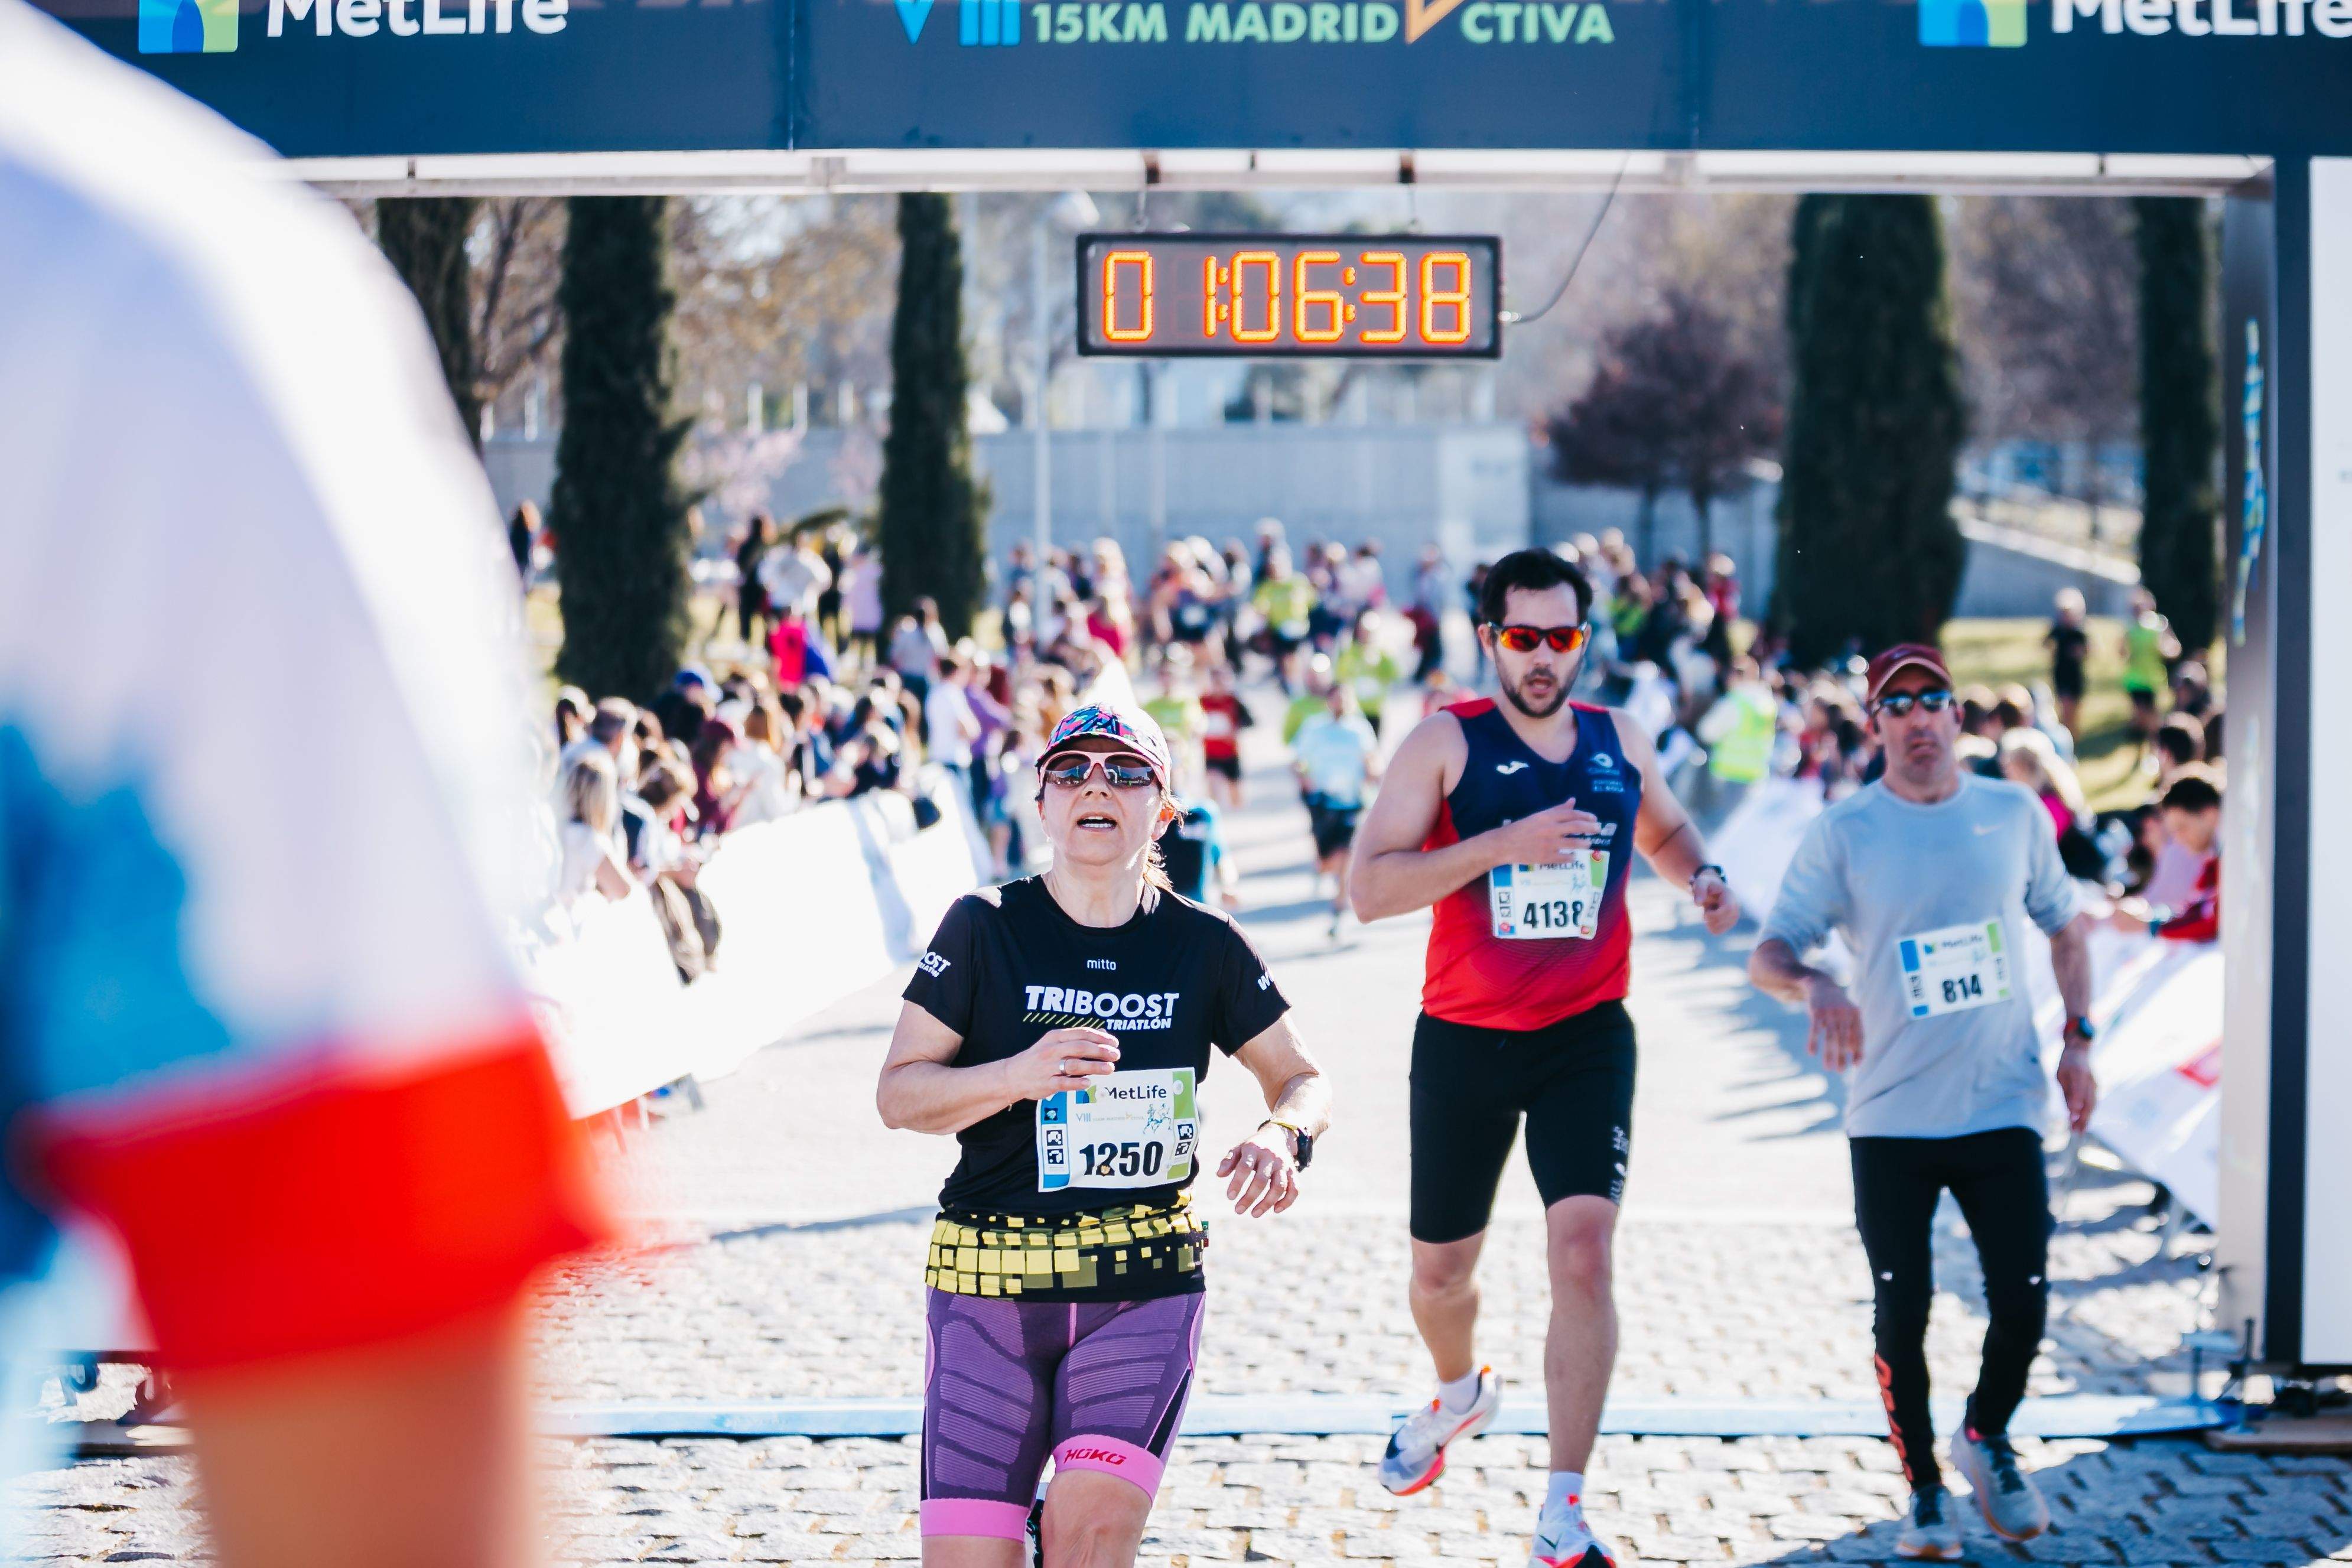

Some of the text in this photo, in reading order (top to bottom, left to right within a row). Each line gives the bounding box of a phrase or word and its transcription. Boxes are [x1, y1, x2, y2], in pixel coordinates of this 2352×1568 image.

[1030, 2, 1169, 43] 15KM
[1186, 2, 1399, 43] MADRID
[1105, 251, 1153, 341] 0
[1524, 900, 1583, 929] 4138
[1087, 959, 1116, 970] mitto
[1025, 985, 1179, 1018] TRIBOOST
[1943, 974, 1982, 1003] 814
[1106, 1016, 1171, 1030] TRIATLÓN
[1104, 1085, 1167, 1099] MetLife
[1079, 1141, 1164, 1177] 1250
